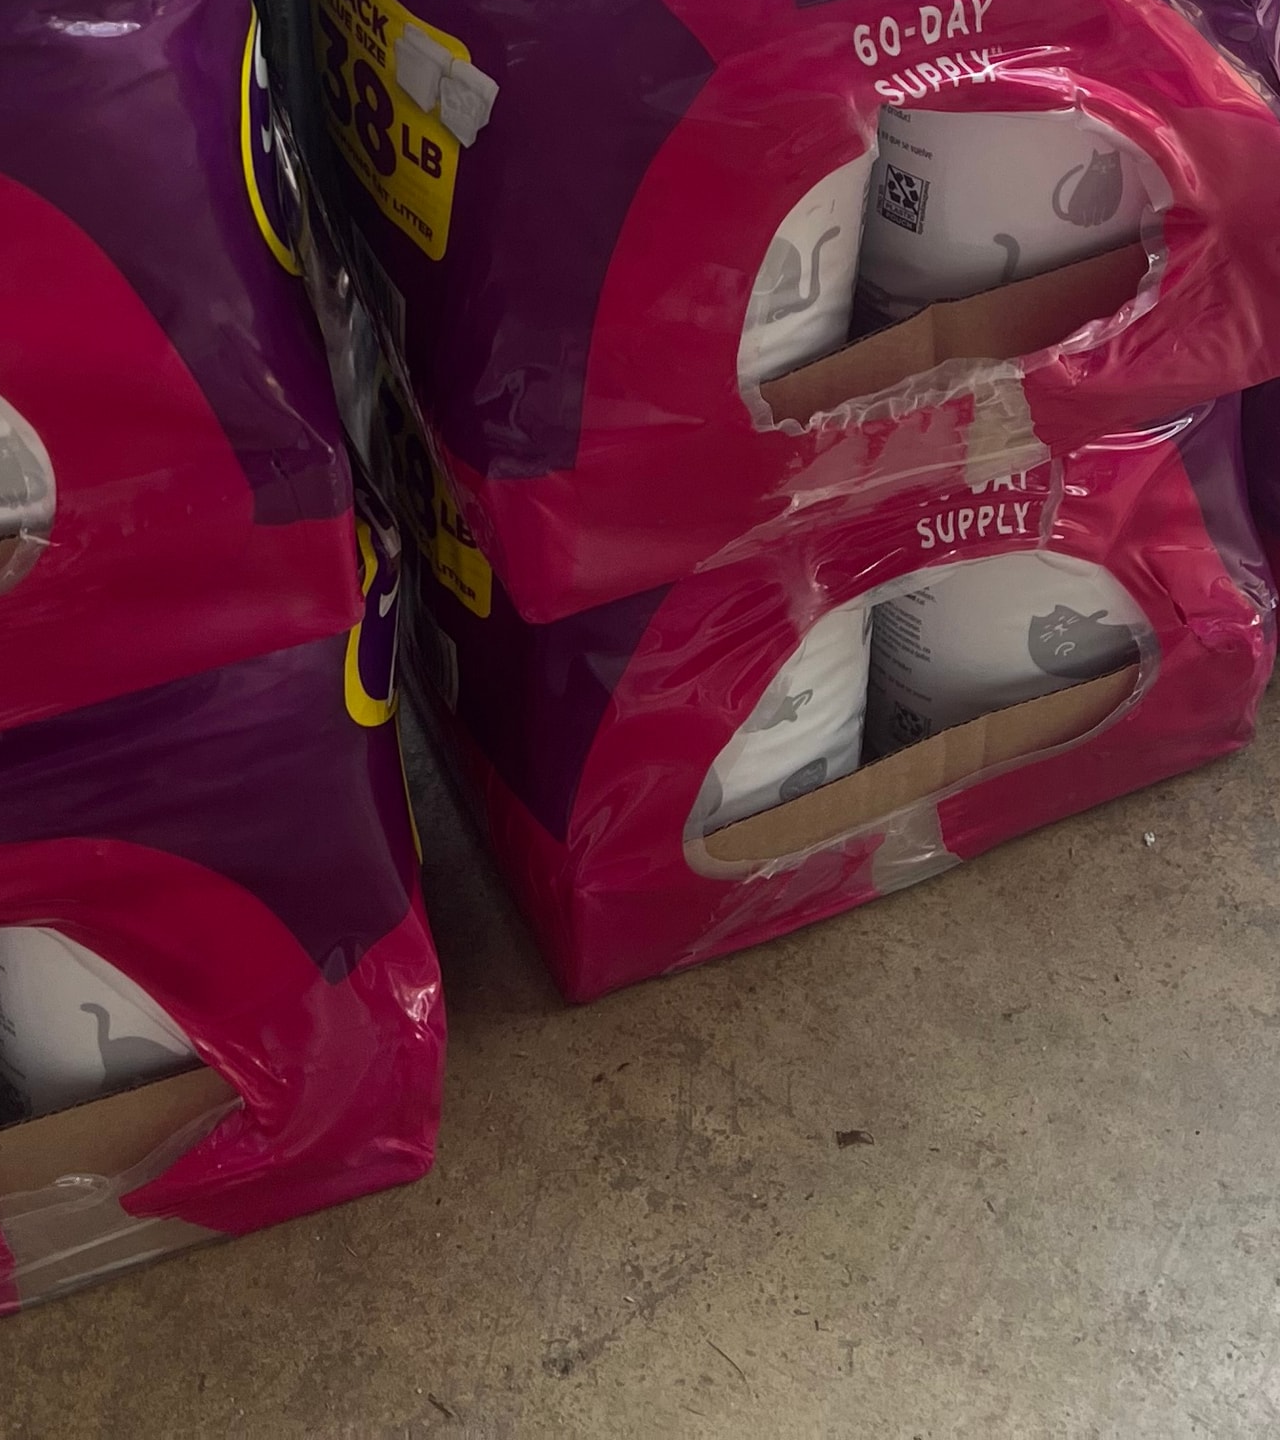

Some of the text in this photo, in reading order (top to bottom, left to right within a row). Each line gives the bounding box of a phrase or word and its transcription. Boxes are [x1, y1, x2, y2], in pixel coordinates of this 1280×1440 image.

[354, 23, 387, 69] SIZE
[318, 3, 443, 180] 38 LB
[874, 48, 997, 107] SUPPLY
[392, 195, 435, 243] LITTER
[915, 501, 1033, 550] SUPPLY
